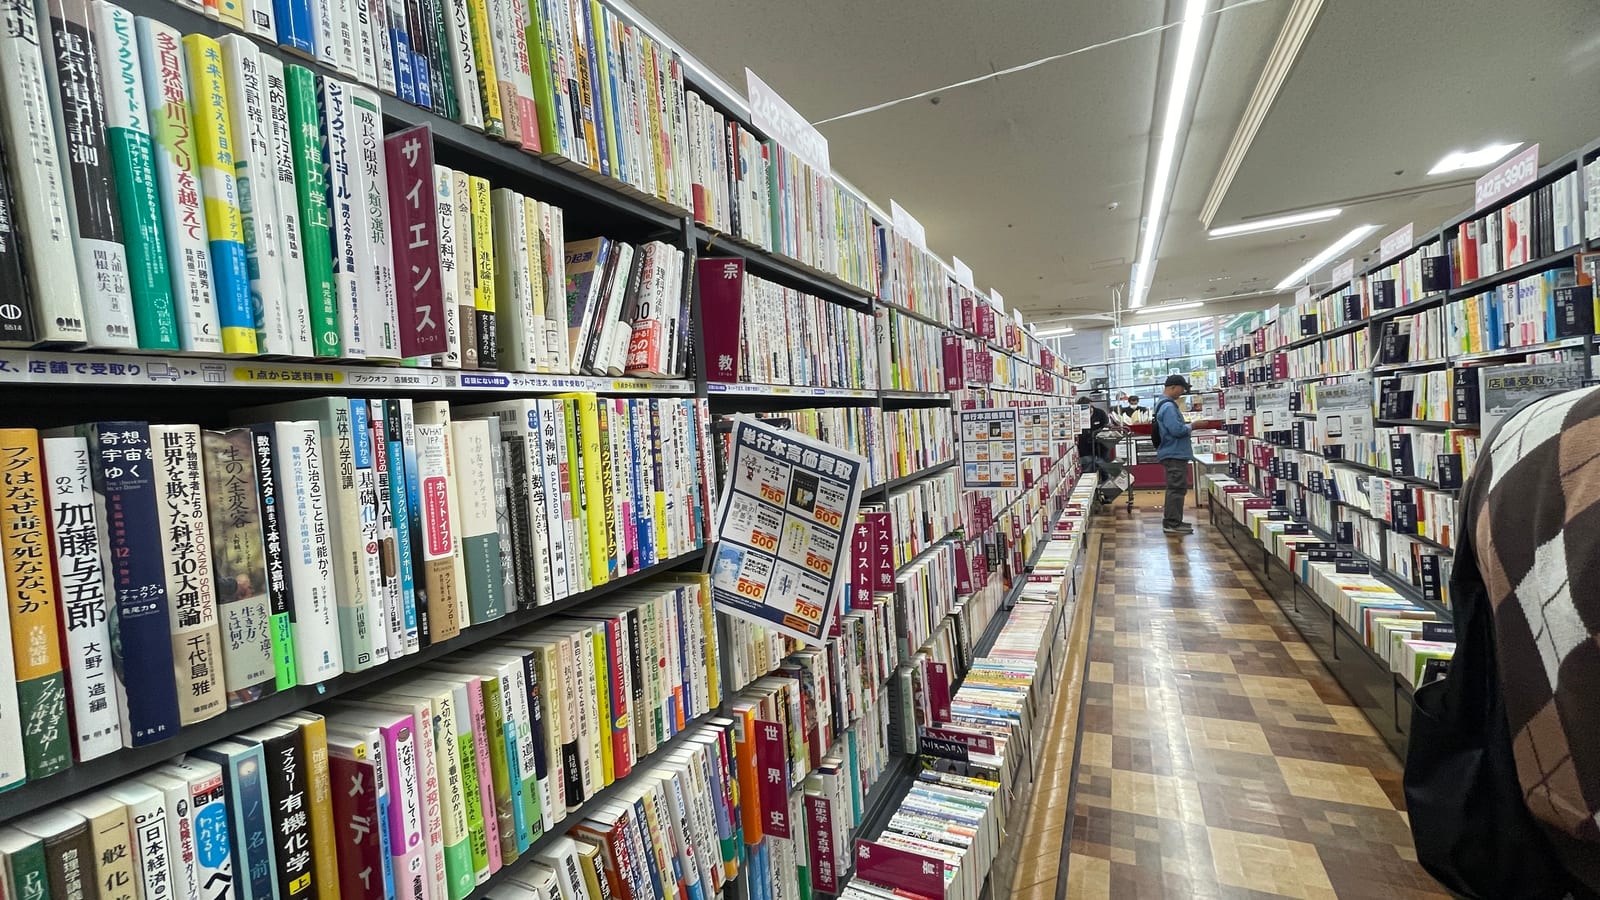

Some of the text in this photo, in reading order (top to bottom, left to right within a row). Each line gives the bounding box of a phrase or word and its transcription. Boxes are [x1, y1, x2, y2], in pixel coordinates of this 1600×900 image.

[56, 30, 99, 167] 電気電子計測
[204, 47, 233, 166] 未来を変える目標
[268, 74, 294, 185] 美的設計方法論
[157, 31, 200, 241] 多自然型川づくりを越えて
[328, 81, 351, 199] ジャック・マイヨール
[361, 112, 378, 178] 成長の限界
[367, 180, 386, 246] 人類の選択
[402, 137, 437, 333] サイエンス
[438, 202, 455, 272] 感じる科学
[93, 250, 112, 293] 関根松夫
[446, 309, 457, 345] さくら剛
[247, 369, 335, 382] 1点から送料無料
[353, 374, 388, 383] ブックオフ
[100, 430, 148, 445] 奇想、
[335, 407, 354, 490] 流体力学30講
[355, 406, 369, 465] 絵ときでわかる
[418, 427, 443, 437] WHAT
[439, 408, 447, 428] サメ
[543, 409, 557, 467] 生命海流
[56, 476, 74, 495] の父
[74, 450, 90, 493] フェライト
[104, 464, 141, 479] ゆく
[184, 431, 203, 519] 天才物理学者たちの
[741, 427, 853, 482] 単行本高価買取
[2, 446, 47, 613] フグはなぜ毒で死なないか
[160, 431, 202, 628] 世界を欺いた科学10大理論
[358, 471, 378, 541] 基礎化学
[378, 472, 392, 530] 星座入門
[435, 480, 451, 551] ホワット・イフ?
[550, 471, 561, 520] GALAPAGOS
[53, 502, 106, 632] 加藤与五郎
[193, 520, 214, 622] SHOCKING SCIENCE
[857, 525, 870, 601] キリスト教
[878, 515, 892, 585] イスラム教
[187, 634, 212, 697] 千代島雅
[228, 610, 244, 651] とは何か
[82, 642, 108, 713] 大野一造編
[401, 744, 418, 829] なぜ?どうして?
[421, 707, 442, 847] 病気が治る人の免疫の法則
[440, 698, 462, 812] 大切な人をどう看取るのか
[764, 725, 786, 827] 世界史
[135, 806, 165, 825] Q&A
[199, 816, 213, 862] わかる!
[214, 808, 227, 855] これなら
[279, 746, 311, 873] マクマリー有機化学
[348, 771, 372, 891] メディ
[100, 822, 131, 900] 一般化
